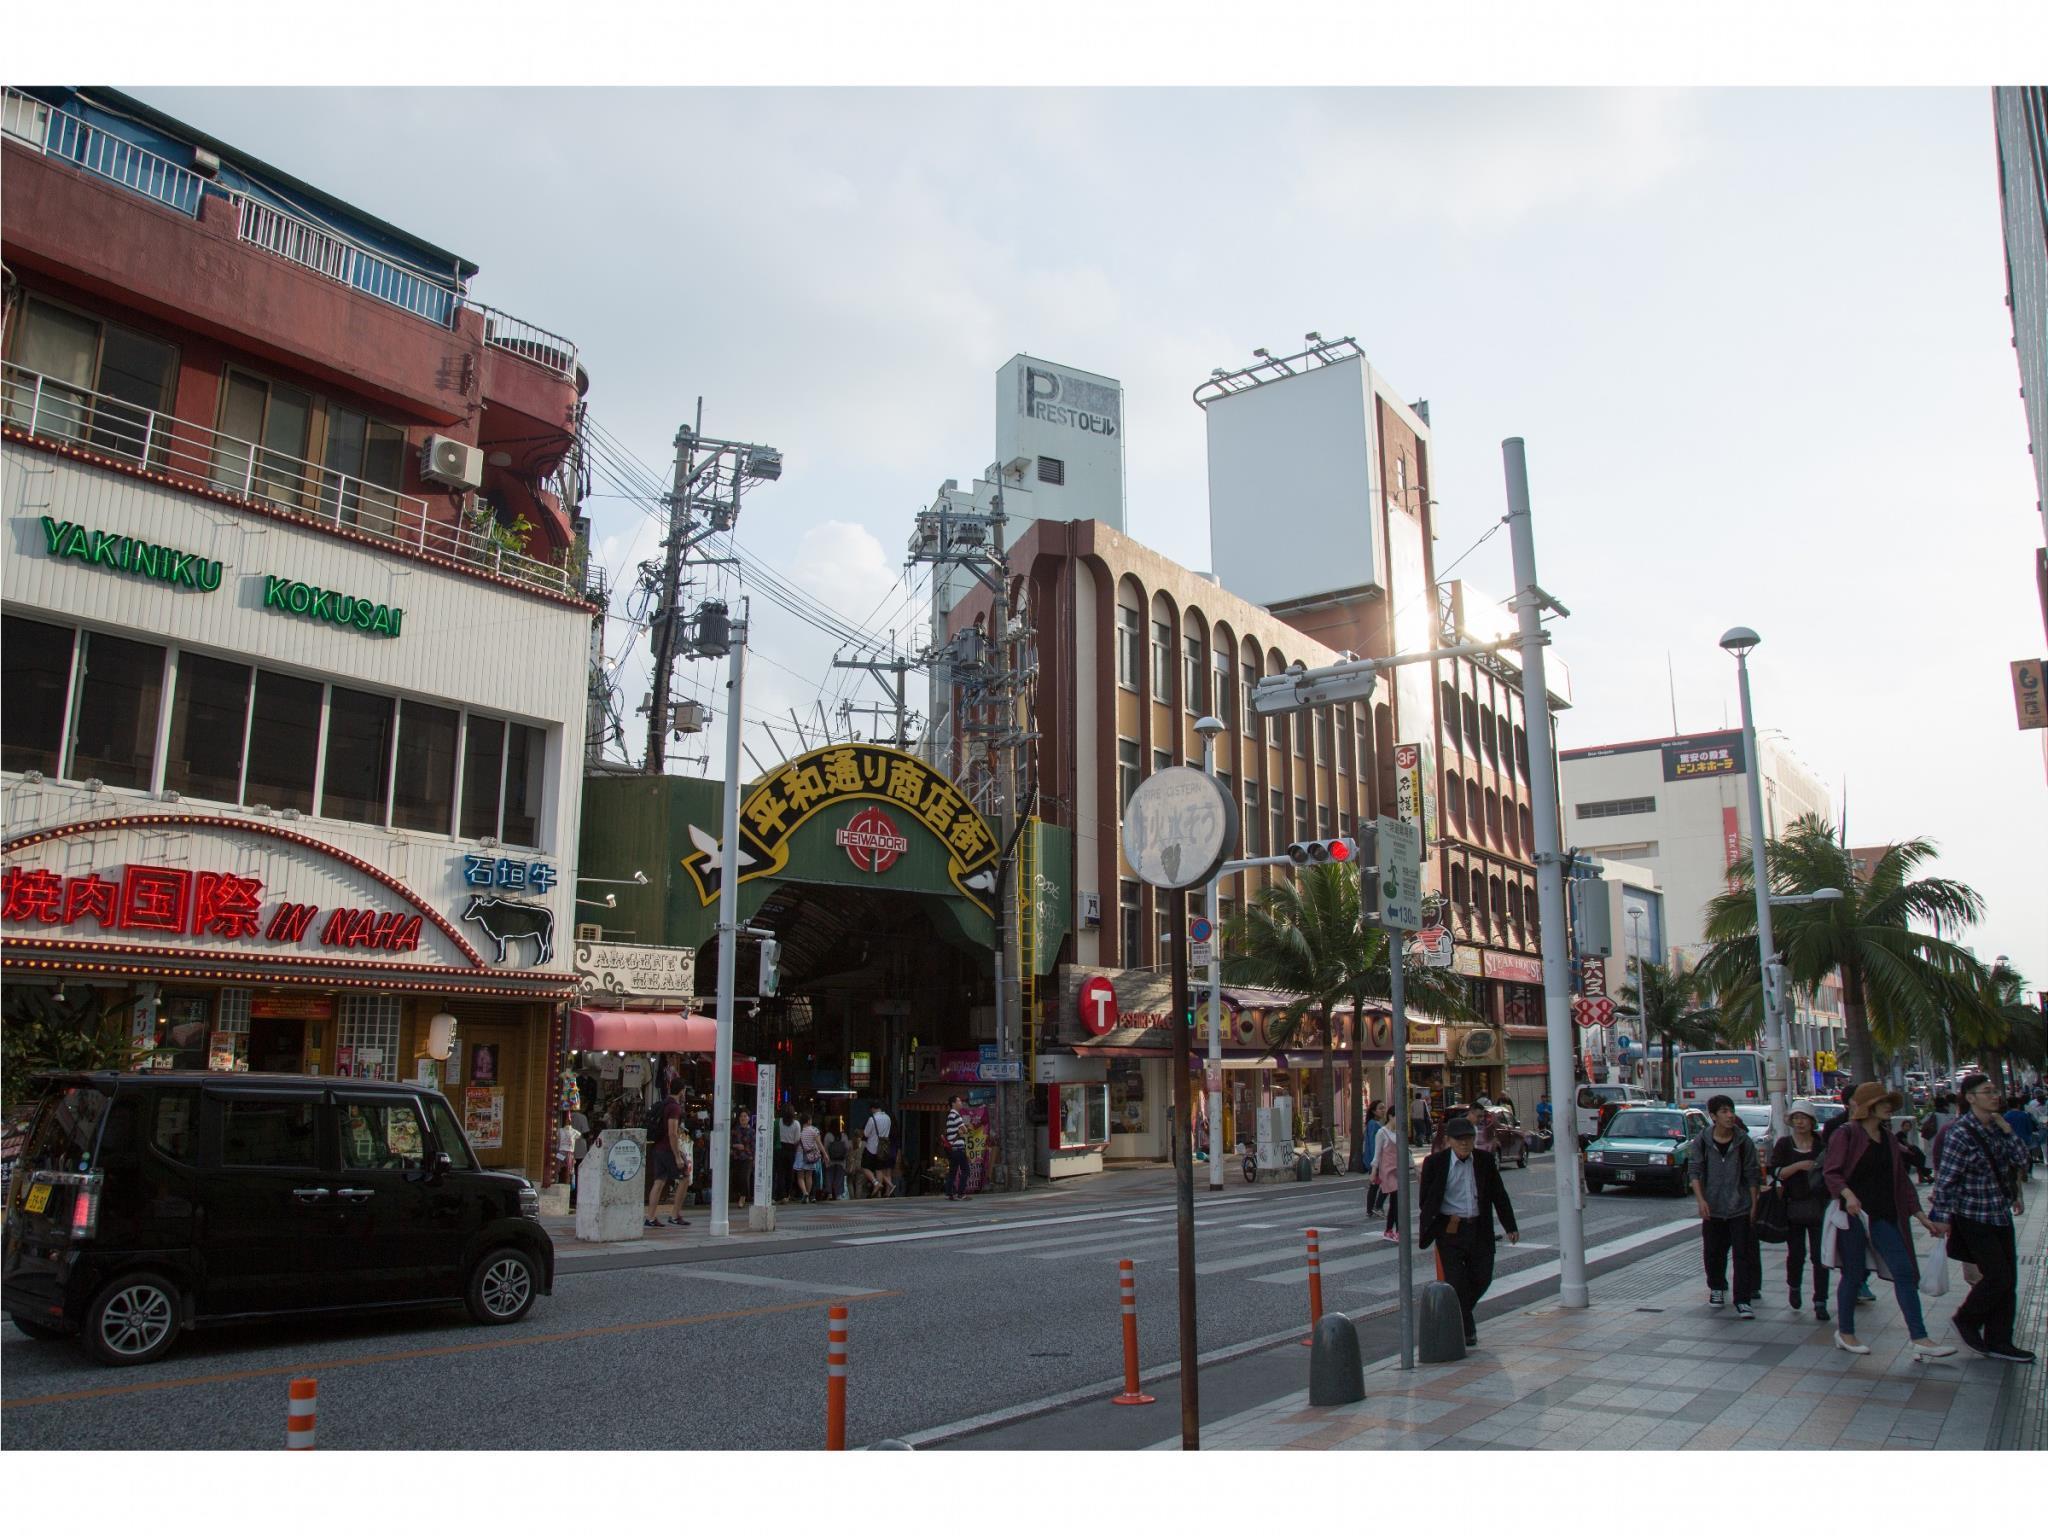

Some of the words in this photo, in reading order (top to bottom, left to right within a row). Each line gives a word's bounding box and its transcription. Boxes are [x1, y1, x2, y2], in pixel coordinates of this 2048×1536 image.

[41, 516, 223, 592] YAKINIKU
[263, 575, 402, 638] KOKUSAI
[1397, 751, 1416, 766] 3F
[1143, 788, 1161, 800] FIRE
[1167, 782, 1202, 798] CISTERN
[747, 749, 988, 861] 平和通り商店街
[841, 831, 906, 850] HEIWADORI
[463, 854, 557, 894] 石垣牛
[1, 864, 264, 938] 焼肉国際
[265, 902, 319, 943] IN
[320, 907, 424, 951] NAHA
[1399, 905, 1417, 925] 130m
[593, 950, 679, 972] ARGENT
[1485, 955, 1515, 976] STEAK
[1516, 958, 1542, 983] HOUSE
[632, 972, 694, 992] HEAR
[1090, 989, 1111, 1027] T
[964, 1136, 986, 1151] 5%
